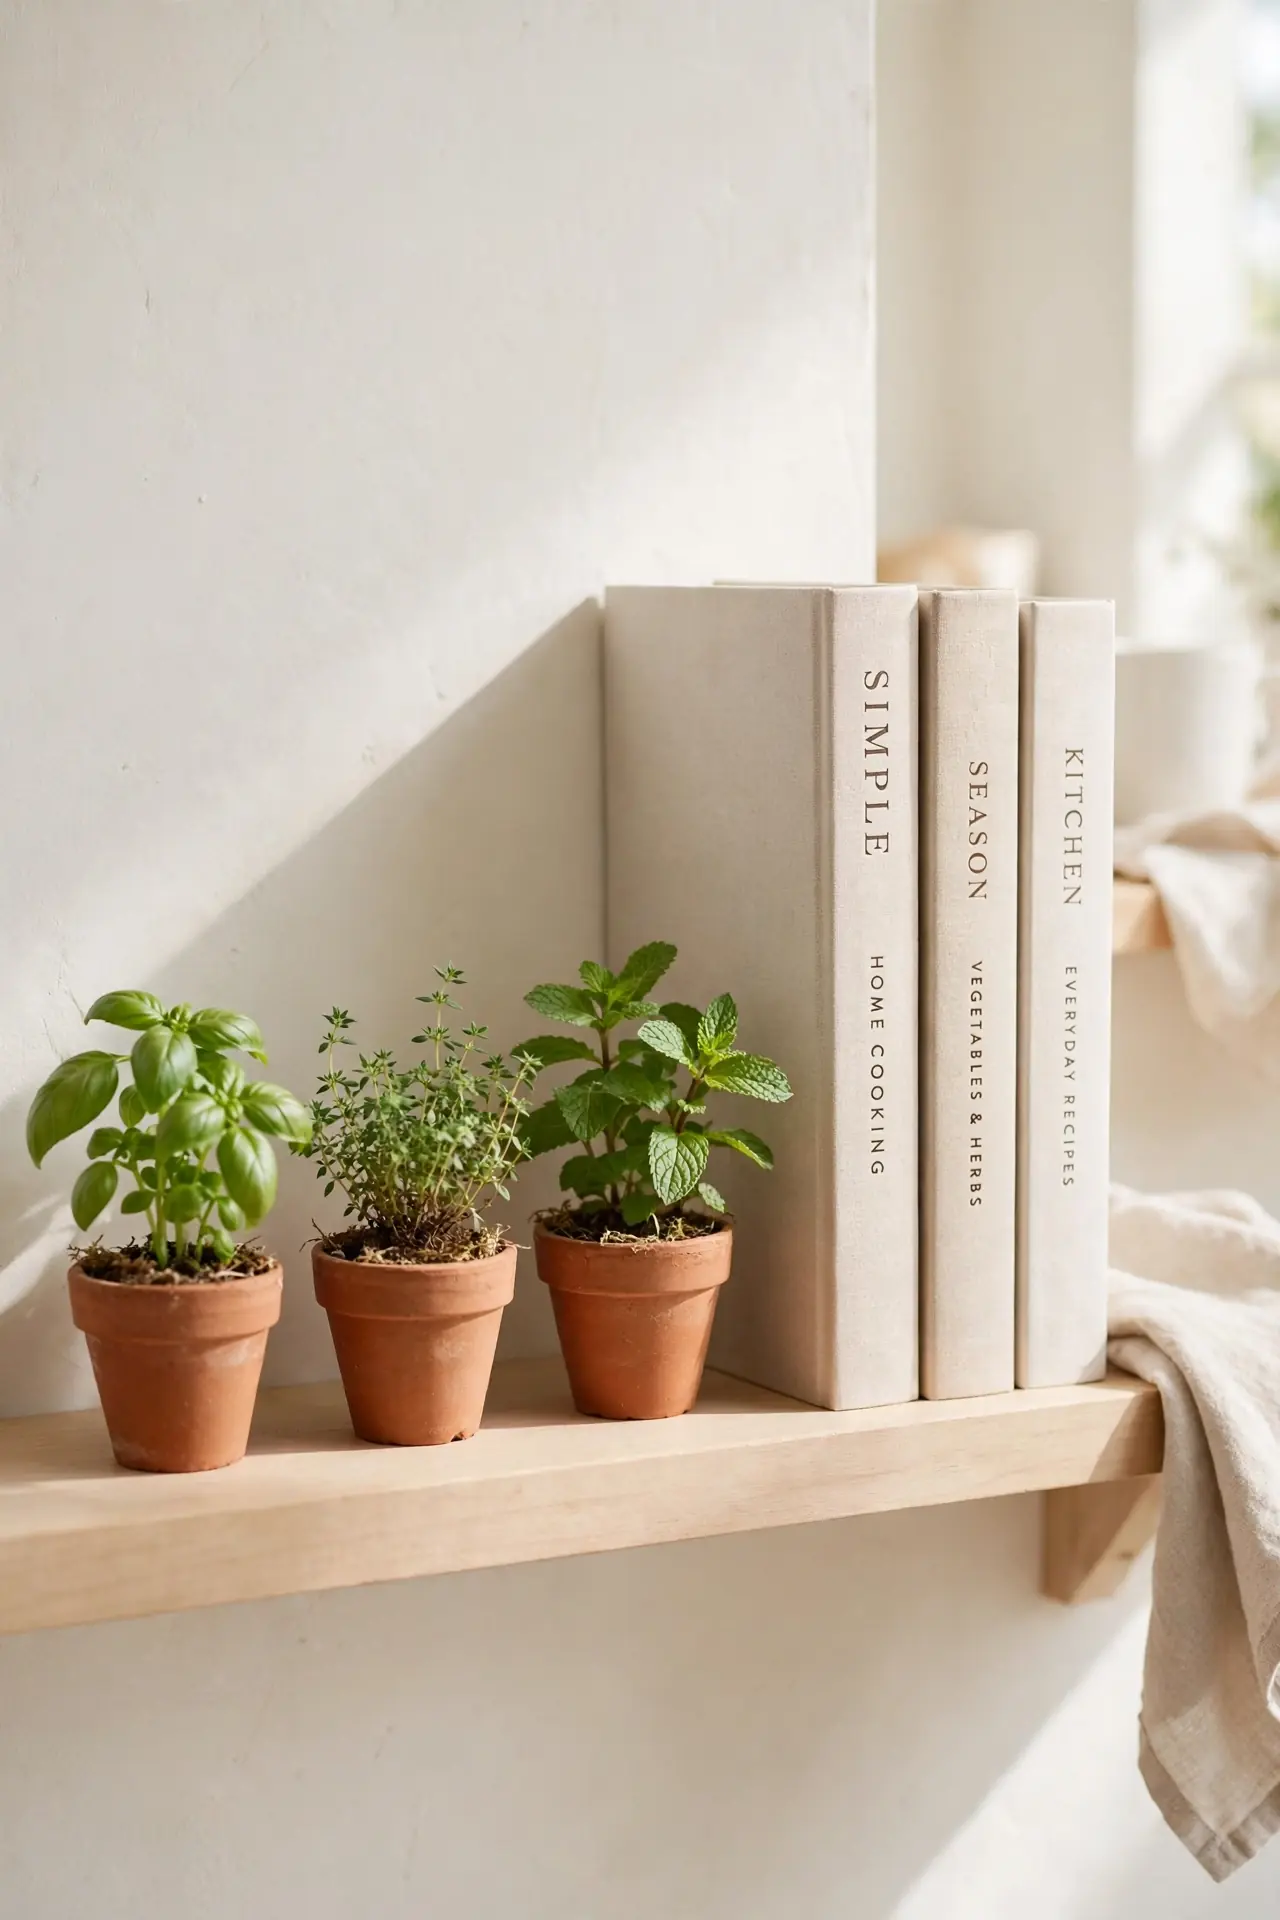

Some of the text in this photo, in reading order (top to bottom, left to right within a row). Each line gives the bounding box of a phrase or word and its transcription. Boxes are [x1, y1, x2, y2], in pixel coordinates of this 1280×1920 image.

[864, 670, 890, 856] SIMPLE
[968, 761, 989, 900] SEASON
[1063, 747, 1084, 905] KITCHEN
[870, 955, 885, 1175] HOME COOKING
[969, 960, 983, 1207] VEGETABLES & HERBS
[1062, 966, 1077, 1187] EVERYDAY RECIPES
